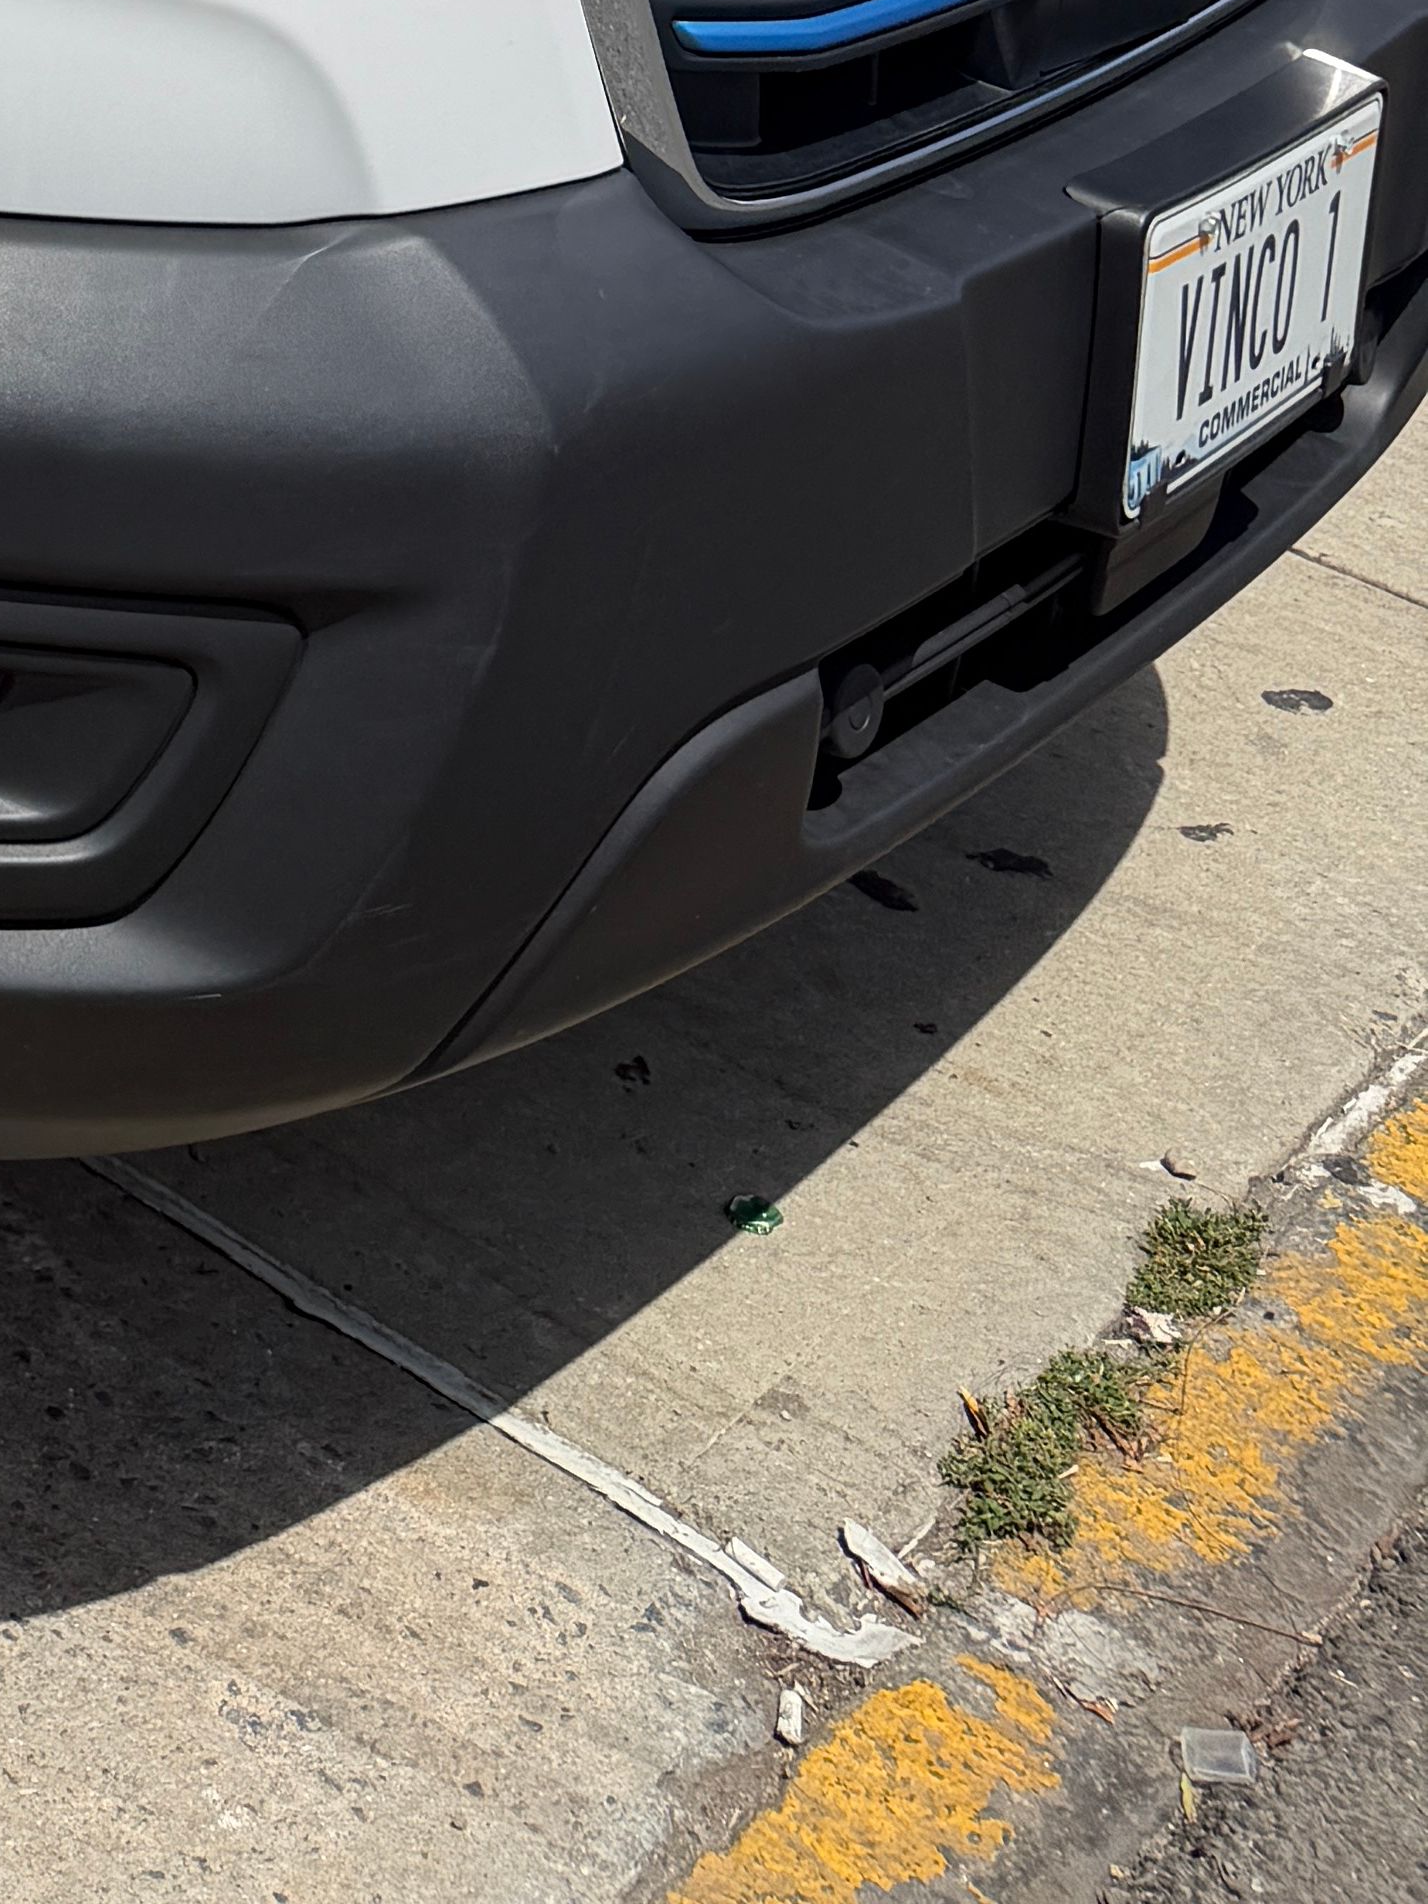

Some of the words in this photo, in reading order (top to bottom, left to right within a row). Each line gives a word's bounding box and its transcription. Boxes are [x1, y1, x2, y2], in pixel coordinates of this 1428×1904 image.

[1213, 184, 1272, 252] NEW
[1272, 143, 1333, 219] YORK
[1174, 218, 1301, 422] VINCO
[1319, 188, 1342, 323] 1
[1197, 350, 1303, 448] COMMERCIAL
